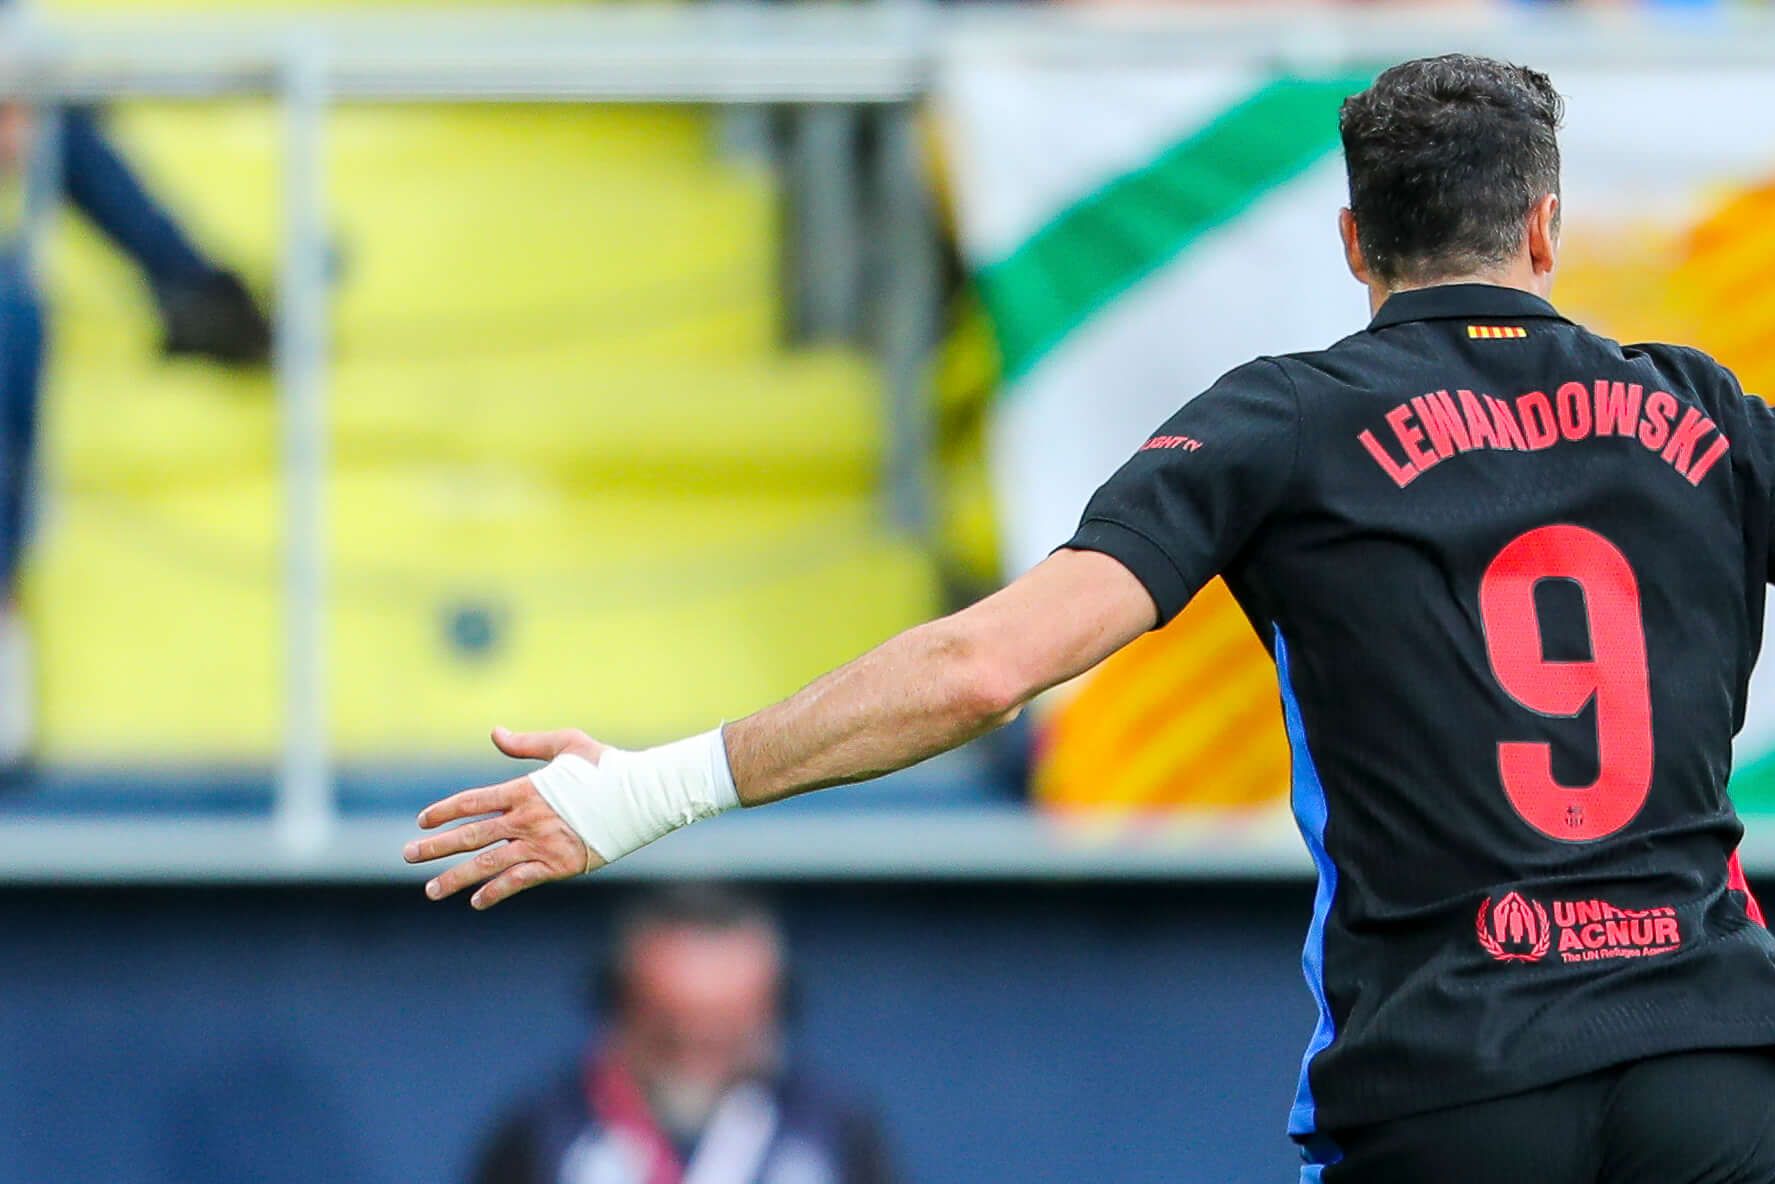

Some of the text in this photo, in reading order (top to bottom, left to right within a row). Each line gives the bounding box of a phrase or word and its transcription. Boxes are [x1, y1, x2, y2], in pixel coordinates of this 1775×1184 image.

[1357, 379, 1730, 489] LEWANDOWSKI
[1478, 524, 1653, 843] 9
[1558, 917, 1680, 951] ACNUR
[1560, 952, 1581, 963] The
[1582, 949, 1600, 961] UN
